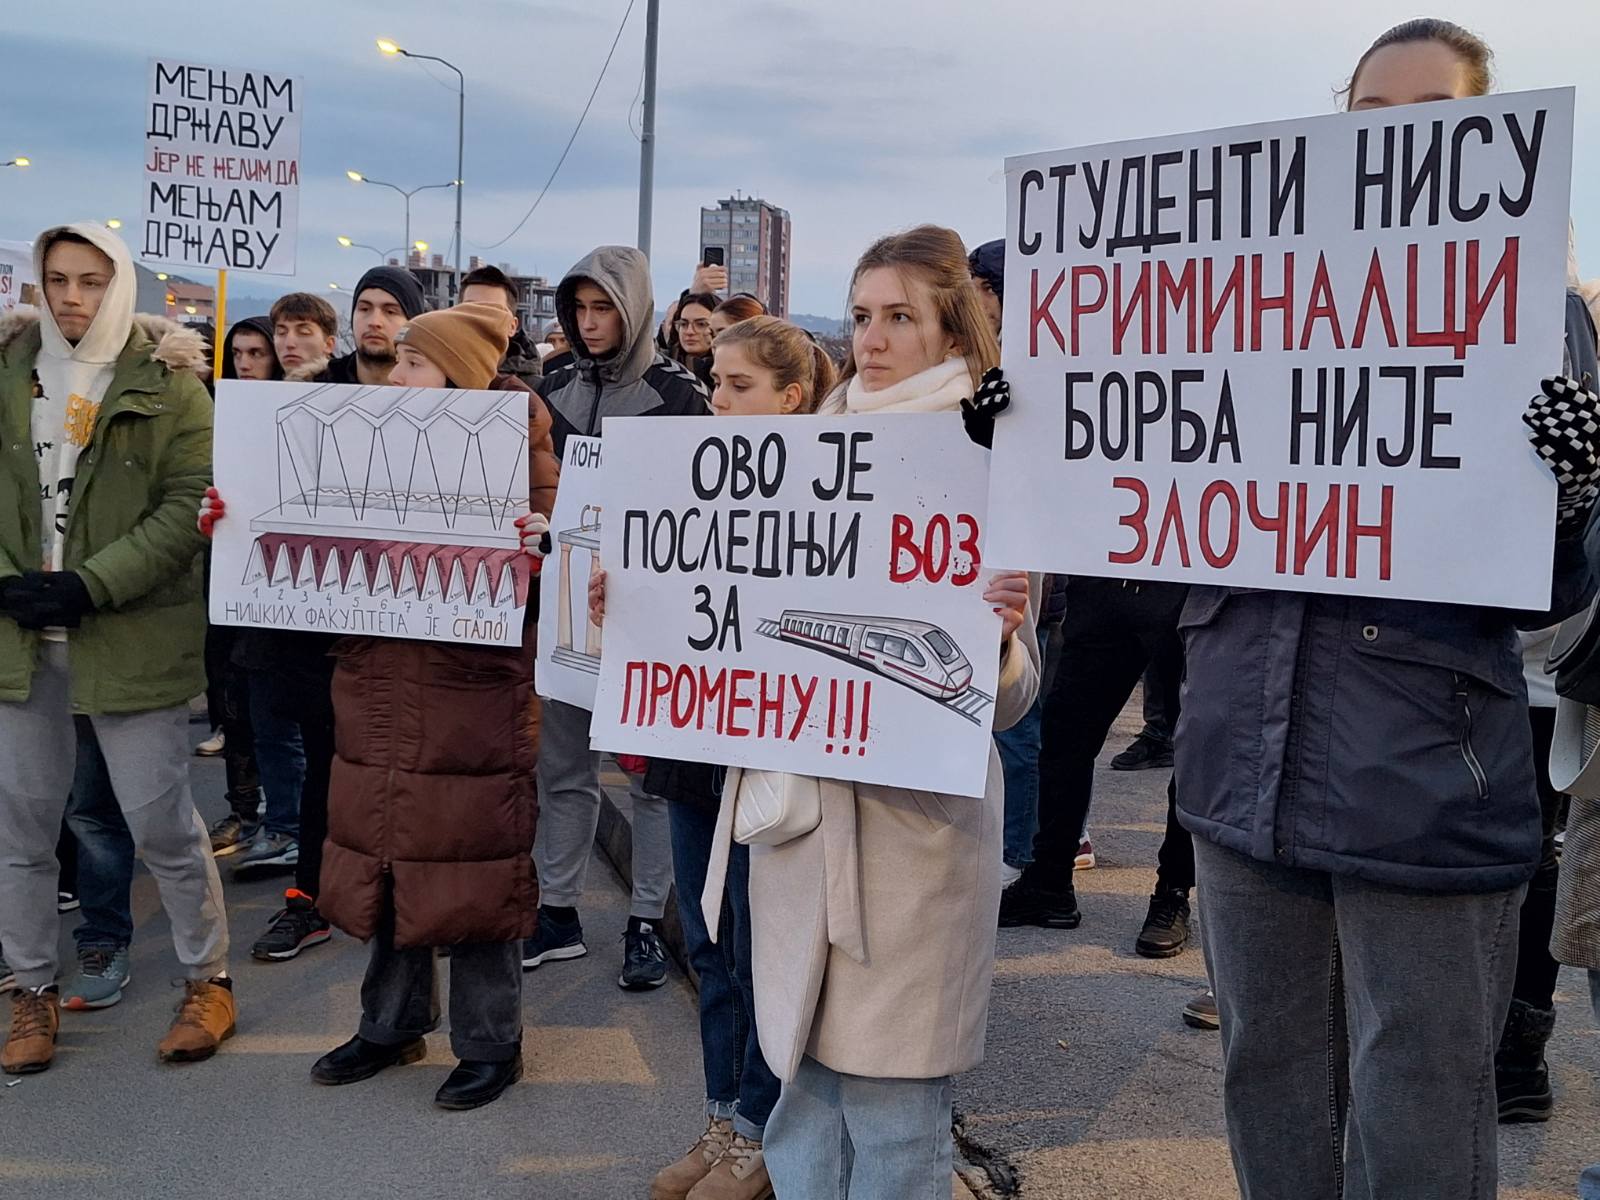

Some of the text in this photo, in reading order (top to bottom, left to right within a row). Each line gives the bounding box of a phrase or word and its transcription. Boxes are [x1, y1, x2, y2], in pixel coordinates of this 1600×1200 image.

[156, 62, 293, 112] МЕЊАМ
[147, 103, 284, 150] ДРЖАВУ
[186, 154, 205, 177] НЕ
[213, 156, 271, 183] ЖЕЛИМ
[275, 160, 298, 185] ДА
[1018, 109, 1547, 257] СТУДЕНТИ НИСУ
[150, 181, 281, 228] МЕЊАМ
[141, 220, 279, 270] ДРЖАВУ
[1029, 236, 1520, 360] КРИМИНАЛЦИ
[1064, 364, 1465, 469] БОРБА НИЈЕ
[570, 440, 603, 469] КОН
[691, 432, 874, 501] ОВО ЈЕ
[623, 507, 982, 587] ПОСЛЕДЊИ ВОЗ
[1108, 477, 1394, 580] ЗЛОЧИН
[225, 602, 297, 626] НИШКИХ
[305, 607, 409, 634] ФАКУЛТЕТА
[424, 616, 441, 637] ЈЕ
[252, 587, 507, 622] 1 2 3 4 5 6 7 8 9 10 11
[687, 584, 742, 653] ЗА
[620, 660, 872, 757] ПРОМЕНУ!!!
